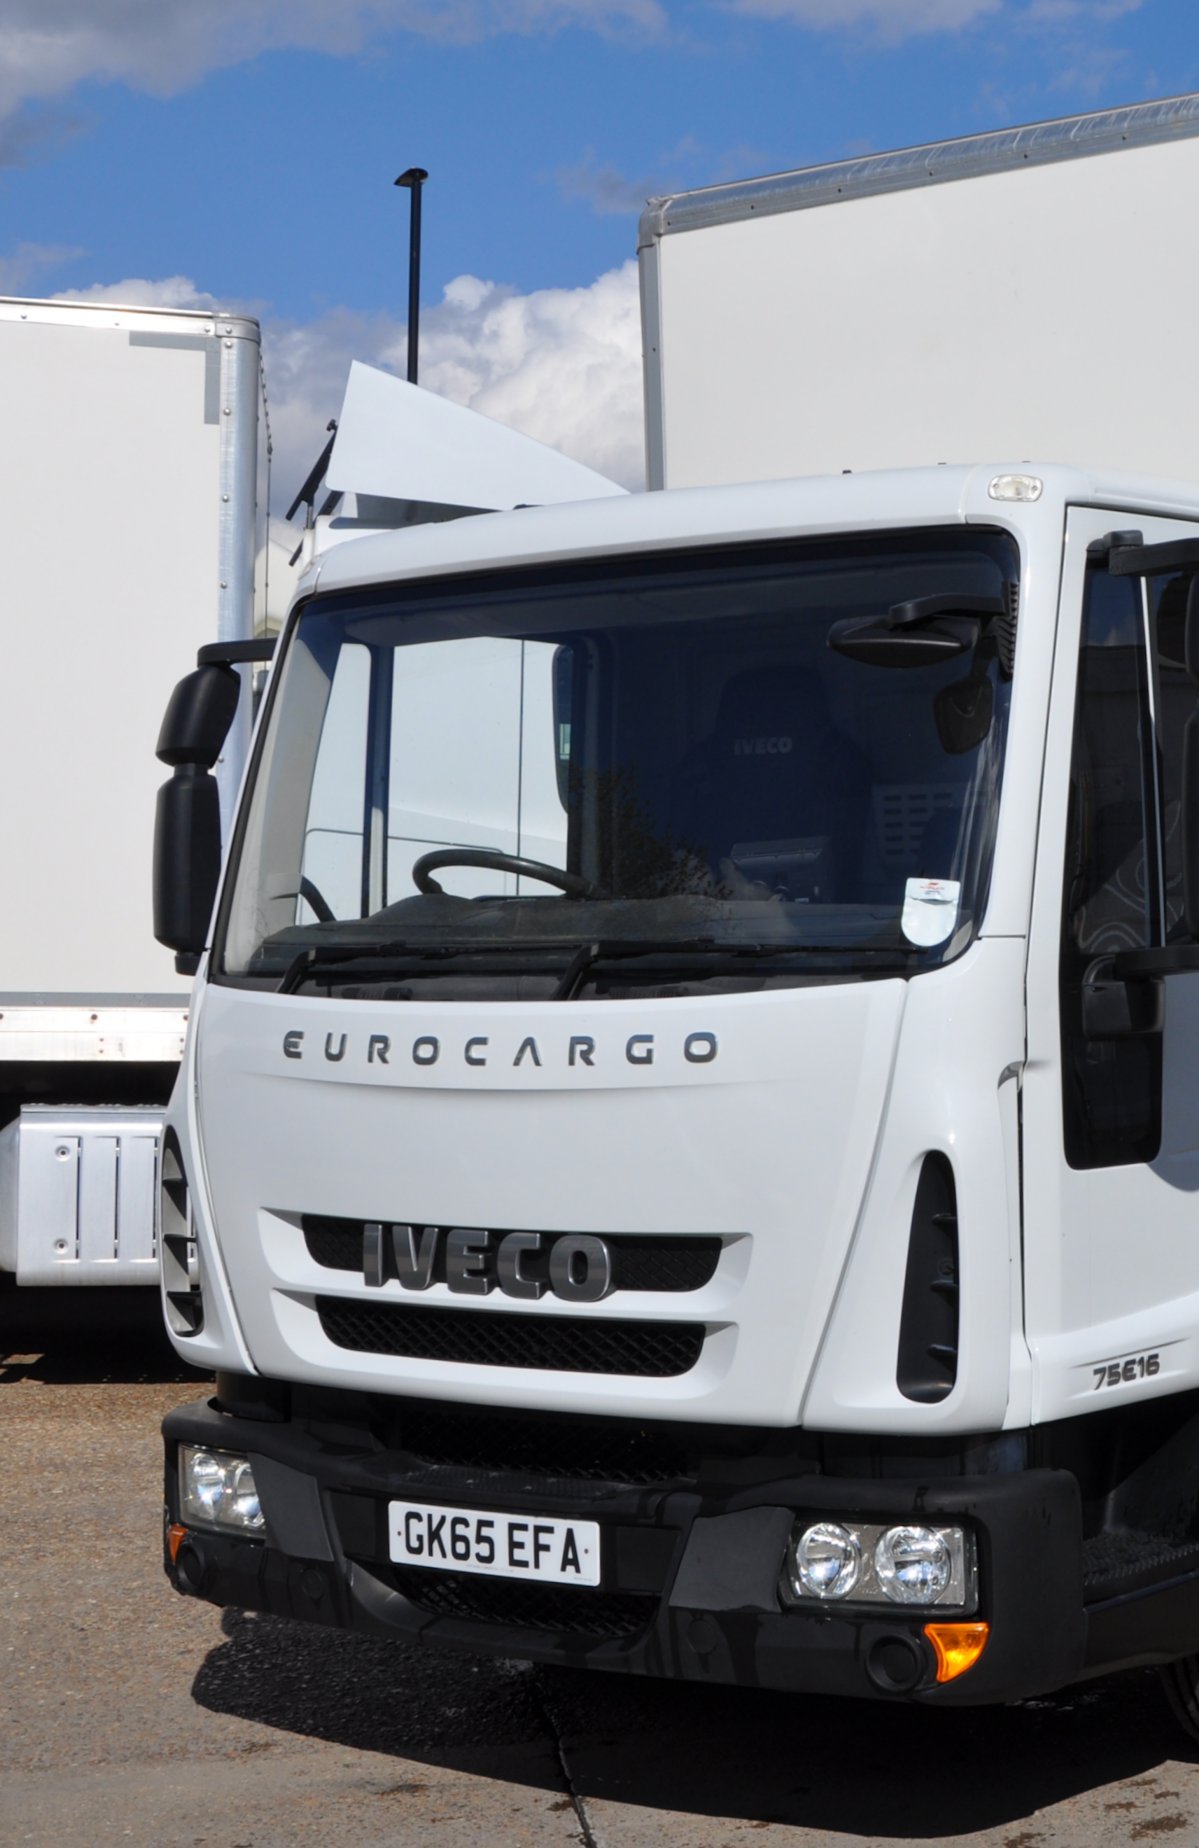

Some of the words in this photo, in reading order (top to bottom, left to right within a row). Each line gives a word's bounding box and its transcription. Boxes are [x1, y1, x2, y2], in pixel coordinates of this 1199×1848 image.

[734, 738, 792, 755] IVECO
[283, 1030, 718, 1067] EUROCARGO
[363, 1223, 612, 1303] IVECO
[1093, 1353, 1160, 1391] 75E16
[404, 1511, 495, 1564] GK65
[508, 1522, 581, 1574] EFA
